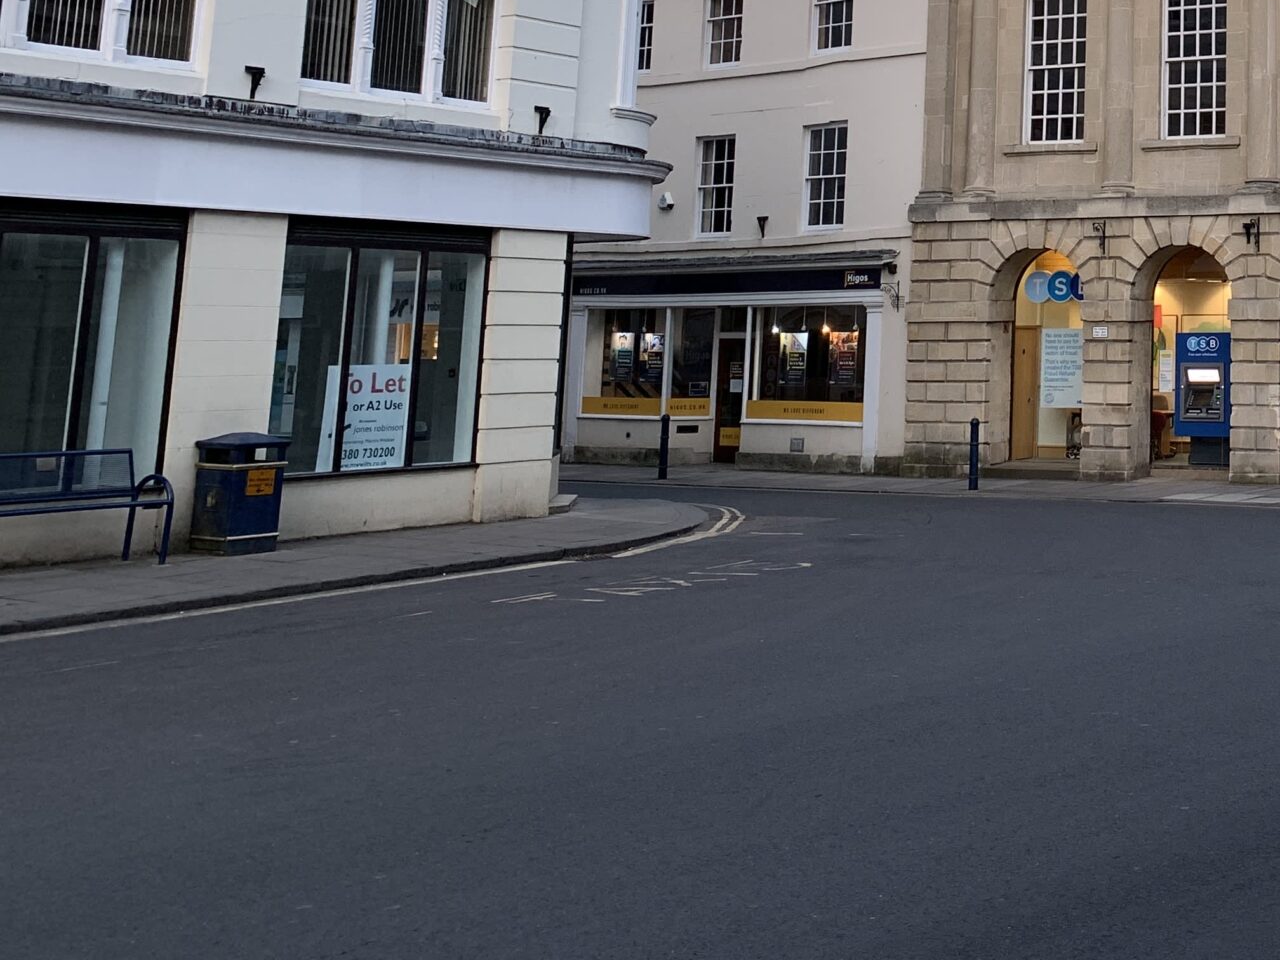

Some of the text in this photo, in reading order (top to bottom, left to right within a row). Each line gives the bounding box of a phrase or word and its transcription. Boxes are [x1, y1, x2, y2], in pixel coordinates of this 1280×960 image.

[847, 273, 869, 284] Higos
[1190, 339, 1217, 348] TSB
[370, 372, 407, 394] Let
[352, 403, 365, 412] or
[366, 400, 381, 411] A2
[384, 400, 404, 411] Use
[341, 446, 396, 460] 380 730200
